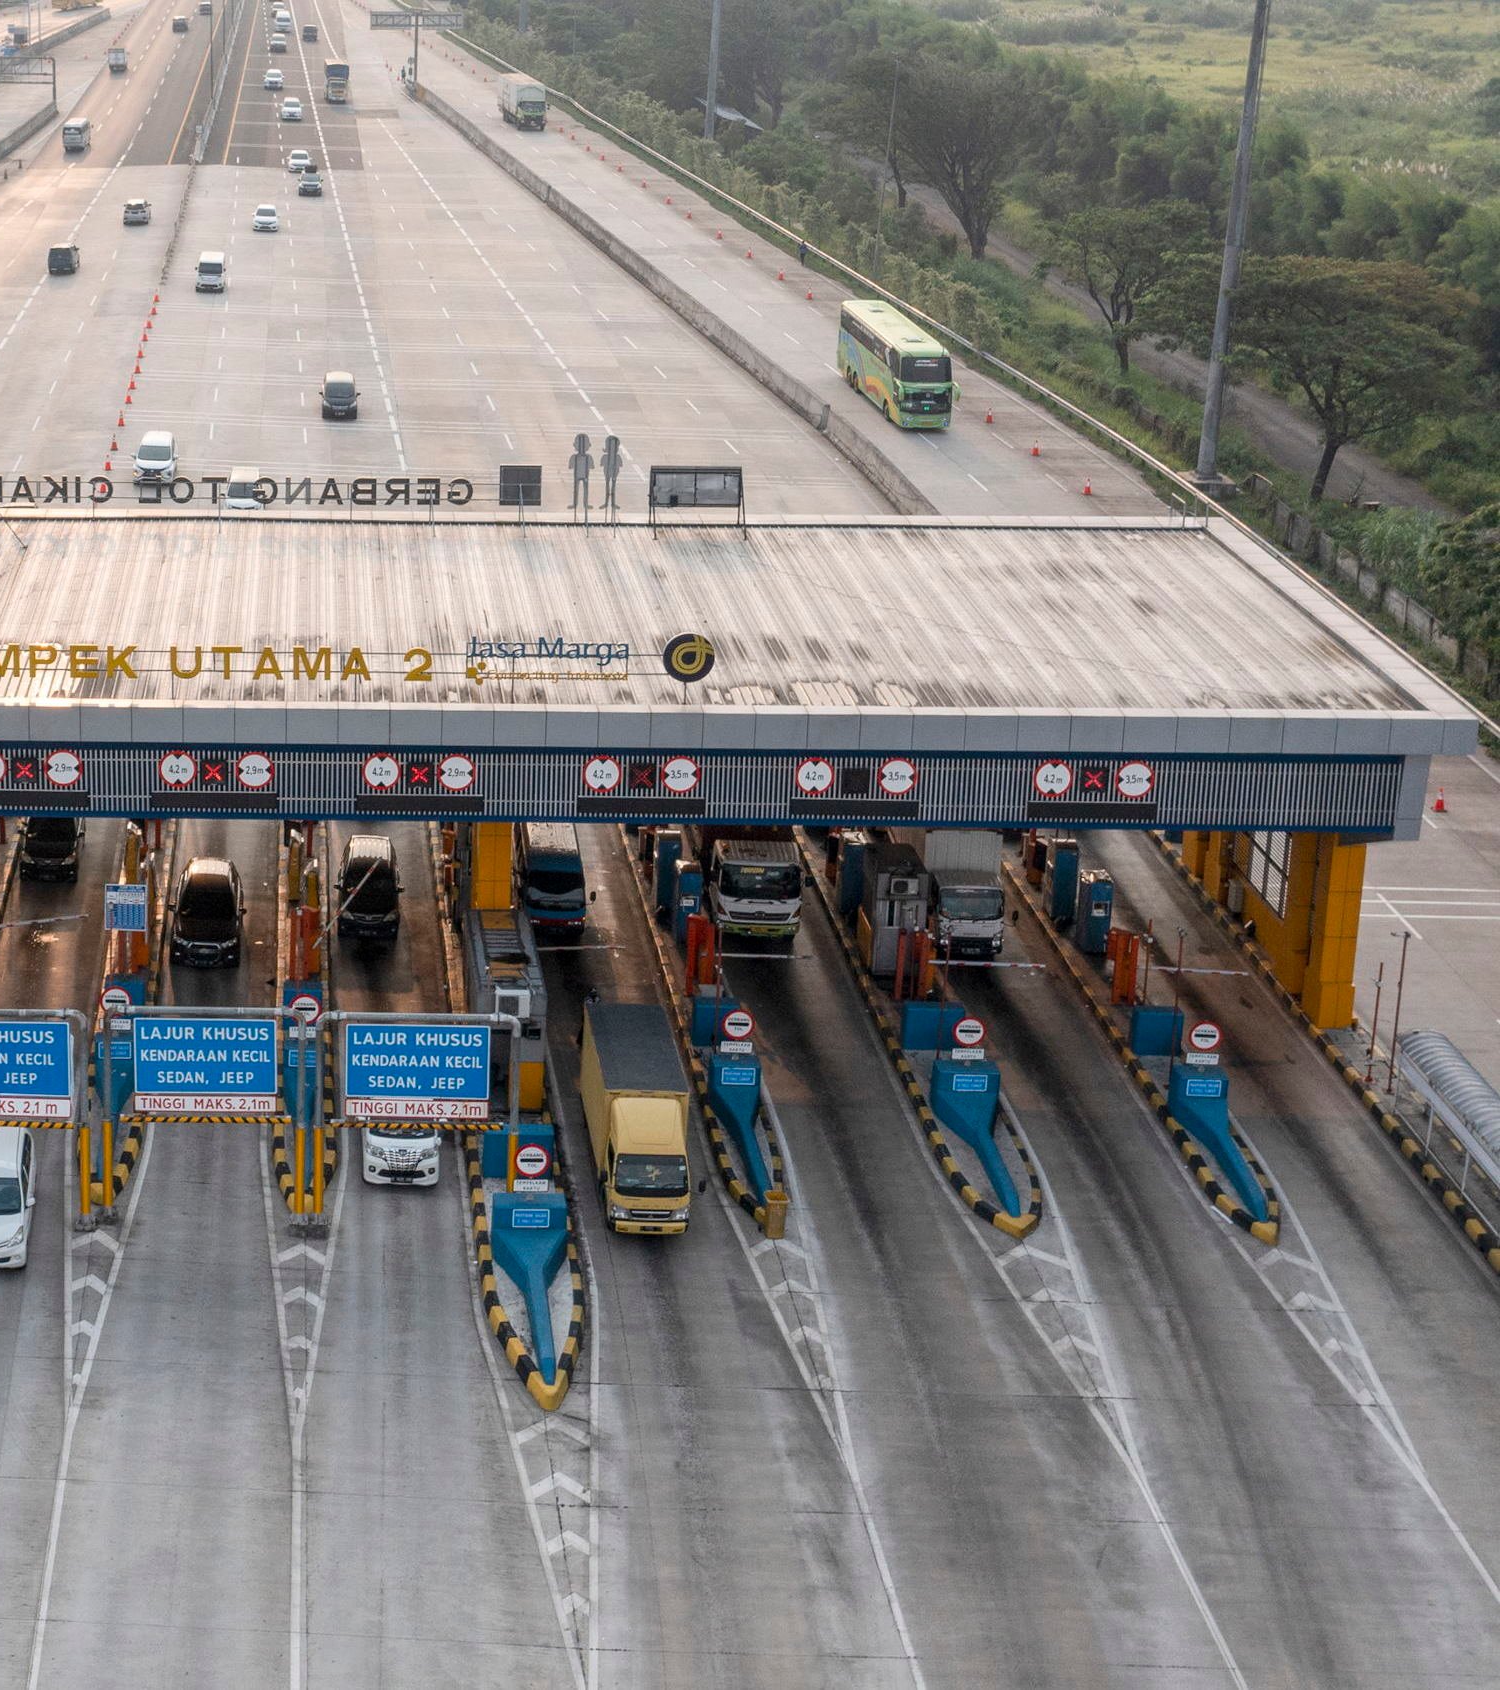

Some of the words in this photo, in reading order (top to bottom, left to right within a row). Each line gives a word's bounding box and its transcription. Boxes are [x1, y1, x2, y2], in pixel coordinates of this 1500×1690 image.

[468, 636, 527, 659] Jasa
[537, 636, 630, 666] Marga
[170, 645, 372, 681] UTAMA
[403, 648, 433, 682] 2
[141, 1026, 194, 1040] LAJUR
[202, 1027, 269, 1040] KHUSUS
[353, 1032, 407, 1046] LAJUR
[416, 1033, 483, 1047] KHUSUS
[16, 1053, 55, 1066] KECIL
[140, 1049, 227, 1062] KENDARAAN
[232, 1050, 270, 1062] KECIL
[352, 1054, 439, 1067] KENDARAAN
[445, 1056, 483, 1069] KECIL
[4, 1072, 38, 1084] JEEP
[157, 1071, 209, 1085] SEDAN,
[219, 1072, 254, 1084] JEEP
[368, 1076, 422, 1090] SEDAN,
[431, 1077, 465, 1090] JEEP
[141, 1098, 185, 1108] TINGGI
[352, 1102, 397, 1113] TINGGI
